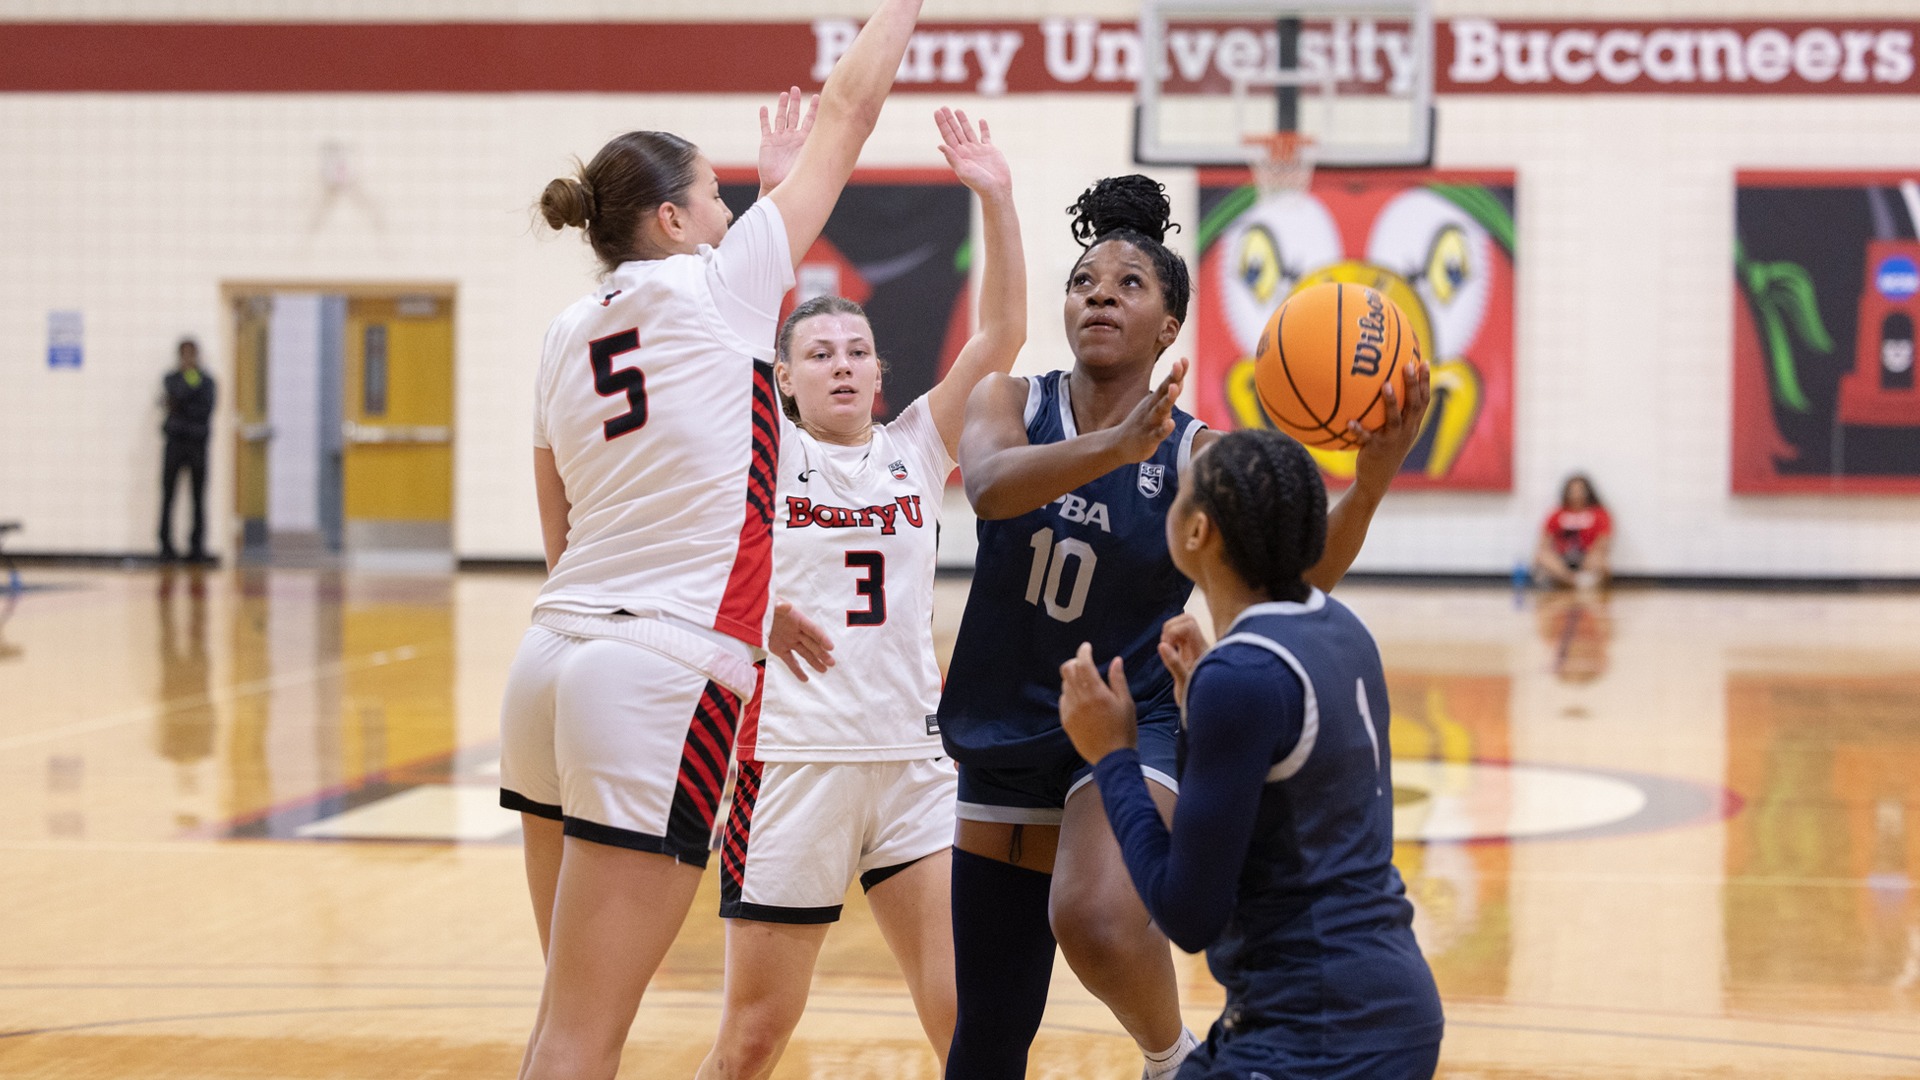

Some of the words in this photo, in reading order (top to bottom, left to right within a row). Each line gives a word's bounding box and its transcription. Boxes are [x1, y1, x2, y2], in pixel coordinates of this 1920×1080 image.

[1449, 17, 1915, 84] Buccaneers
[588, 327, 649, 442] 5
[1142, 465, 1161, 475] SSC
[845, 550, 888, 628] 3
[1025, 527, 1098, 623] 10
